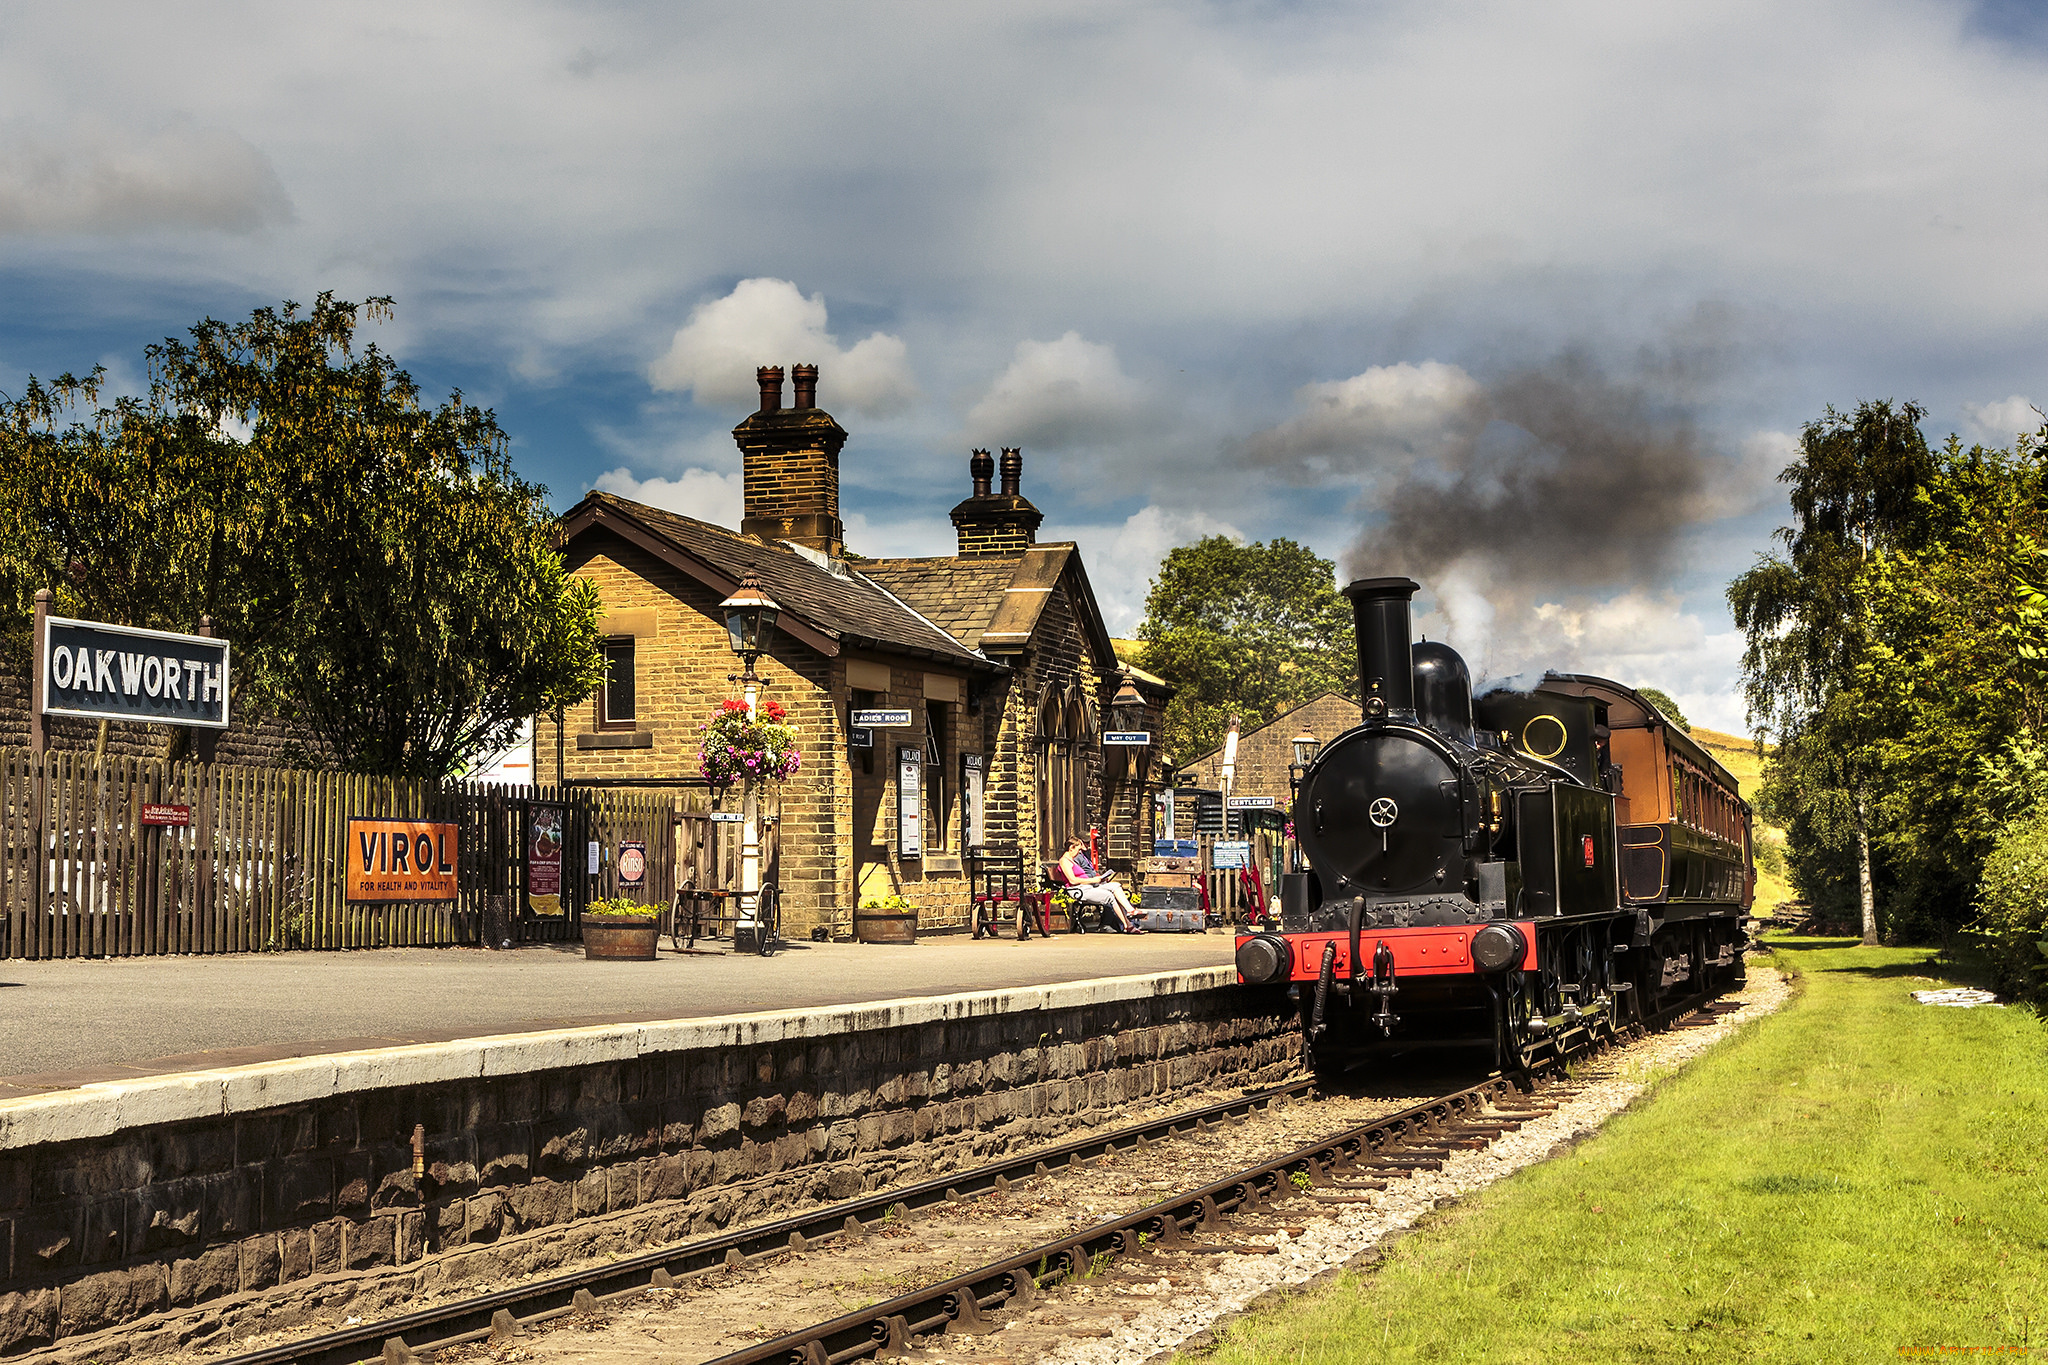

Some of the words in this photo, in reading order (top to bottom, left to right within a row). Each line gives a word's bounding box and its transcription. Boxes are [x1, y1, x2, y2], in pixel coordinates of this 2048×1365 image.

[52, 645, 222, 703] OAKWORTH
[885, 714, 907, 722] ROOM
[901, 749, 919, 761] MIDLAND
[966, 756, 982, 766] MIDLAND
[359, 831, 453, 875] VIROL
[622, 853, 643, 873] Rinso
[360, 882, 375, 891] FOR
[378, 882, 401, 891] HEALTH
[404, 882, 418, 891] AND
[421, 882, 448, 891] VITALITY
